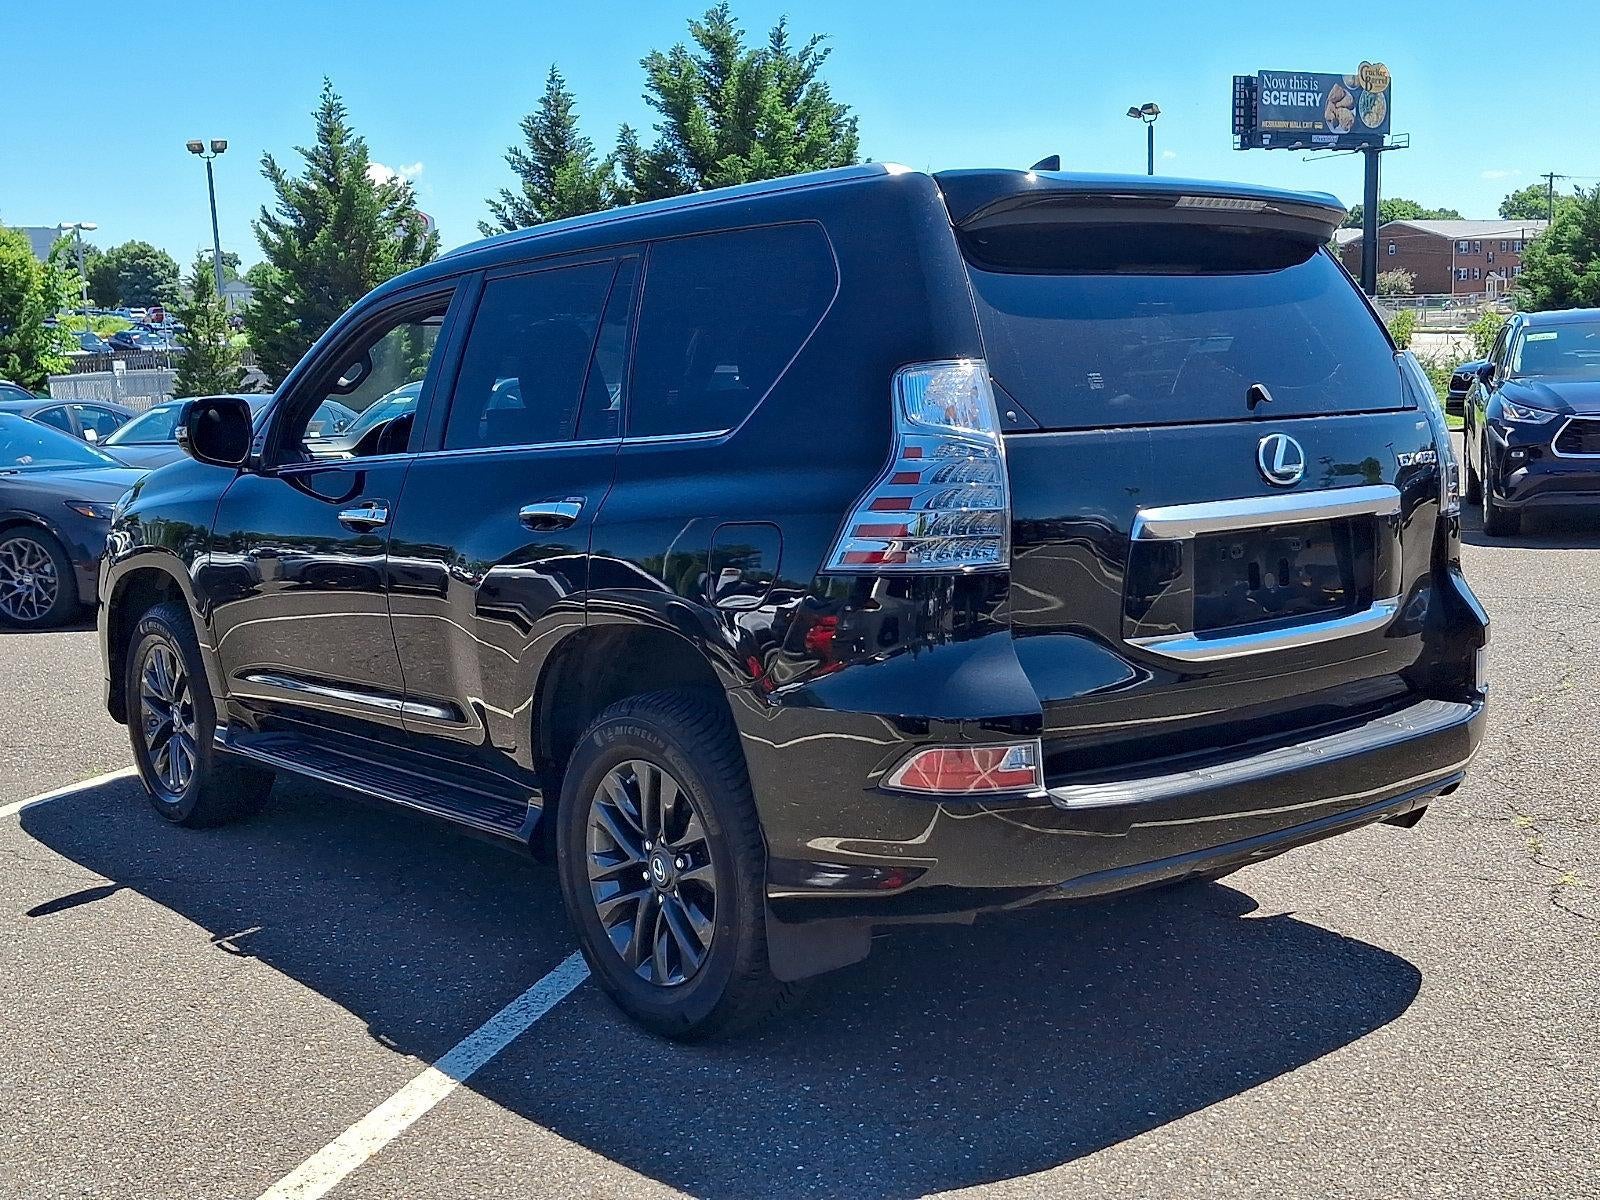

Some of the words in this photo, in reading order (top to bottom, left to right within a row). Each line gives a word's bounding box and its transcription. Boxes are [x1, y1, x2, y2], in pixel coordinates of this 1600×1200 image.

[1263, 74, 1287, 90] Now
[1289, 75, 1309, 90] this
[1310, 76, 1319, 90] is
[1262, 90, 1323, 107] SCENERY
[614, 725, 665, 749] MICHELIN
